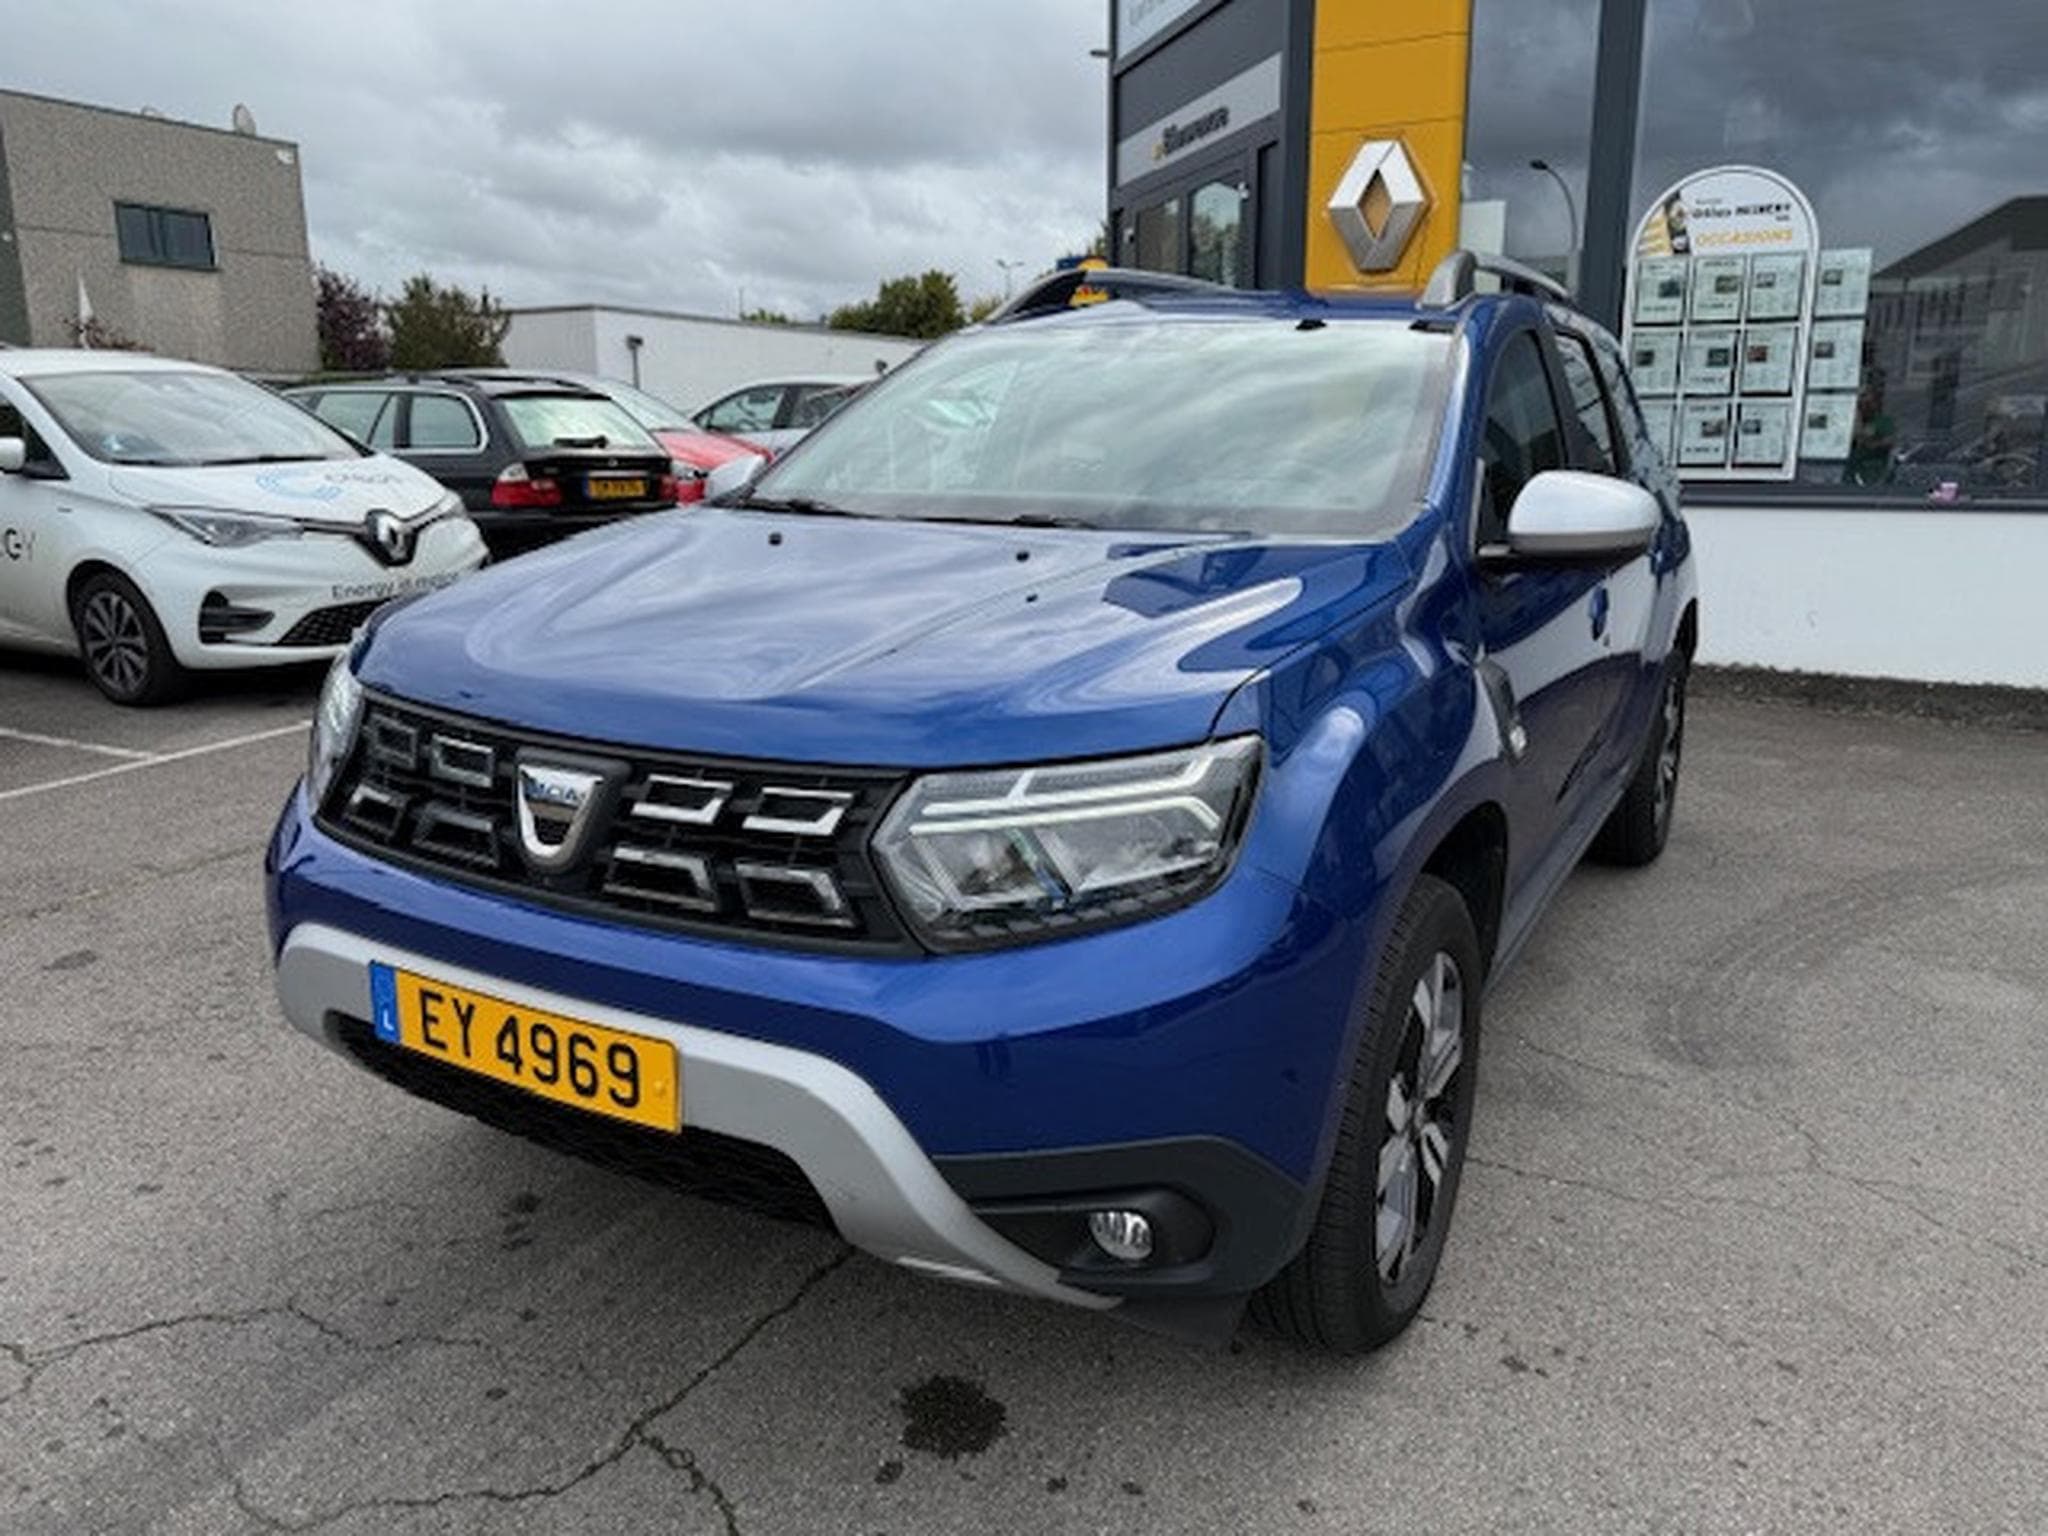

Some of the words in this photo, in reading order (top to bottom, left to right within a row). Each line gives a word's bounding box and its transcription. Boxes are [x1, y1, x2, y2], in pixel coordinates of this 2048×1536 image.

[331, 580, 395, 598] Energy
[382, 1011, 395, 1031] L
[419, 987, 475, 1058] EY
[495, 1015, 641, 1108] 4969
